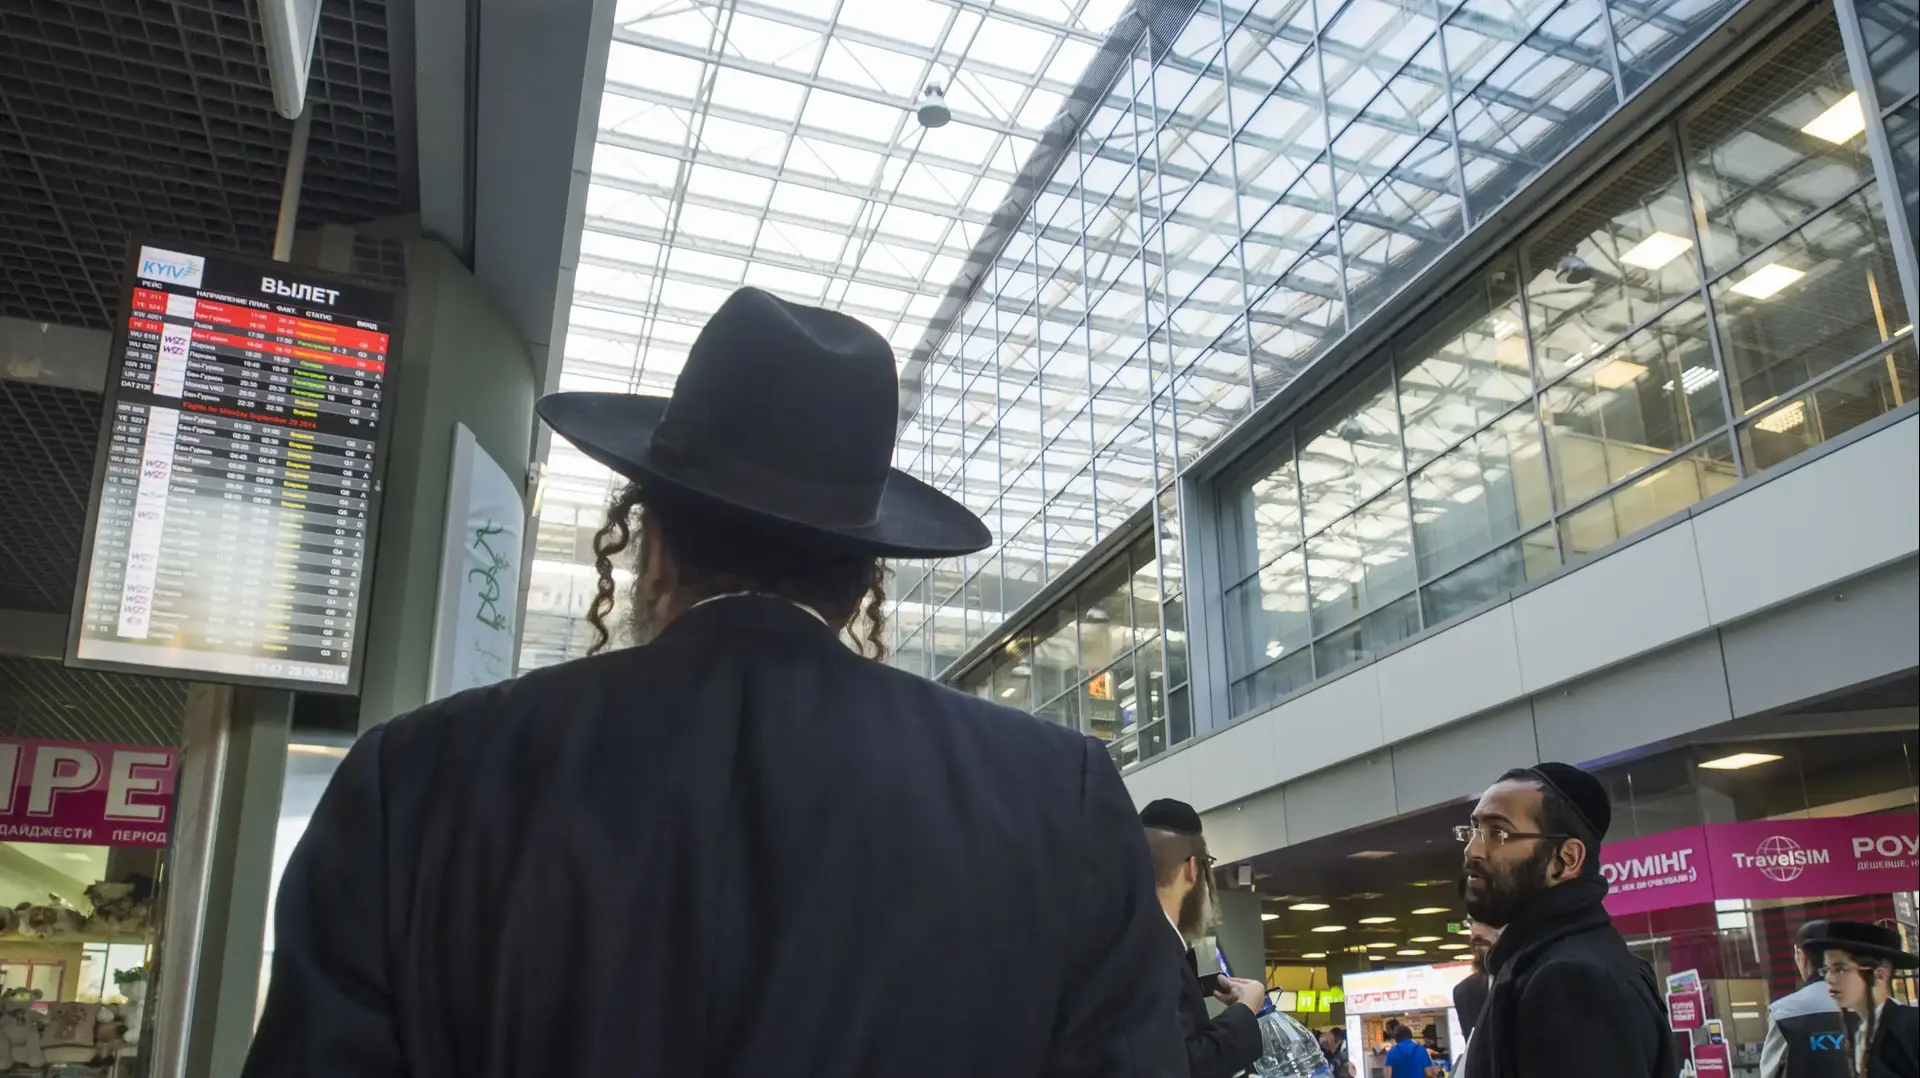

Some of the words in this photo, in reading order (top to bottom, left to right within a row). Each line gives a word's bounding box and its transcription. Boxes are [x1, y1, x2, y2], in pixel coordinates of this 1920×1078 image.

[143, 260, 184, 279] KYIV
[260, 276, 340, 306] ВЫЛЕТ
[142, 280, 162, 289] РЕЙС
[196, 290, 246, 305] НАПРАВЛЕНИЕ
[305, 310, 332, 321] СТАТУС
[164, 335, 186, 346] WIZZ
[162, 345, 184, 356] WIZZ
[207, 405, 217, 413] for
[112, 829, 167, 843] ПЕРІОД
[1732, 849, 1830, 868] TravelSIM
[1810, 1034, 1845, 1050] KY
